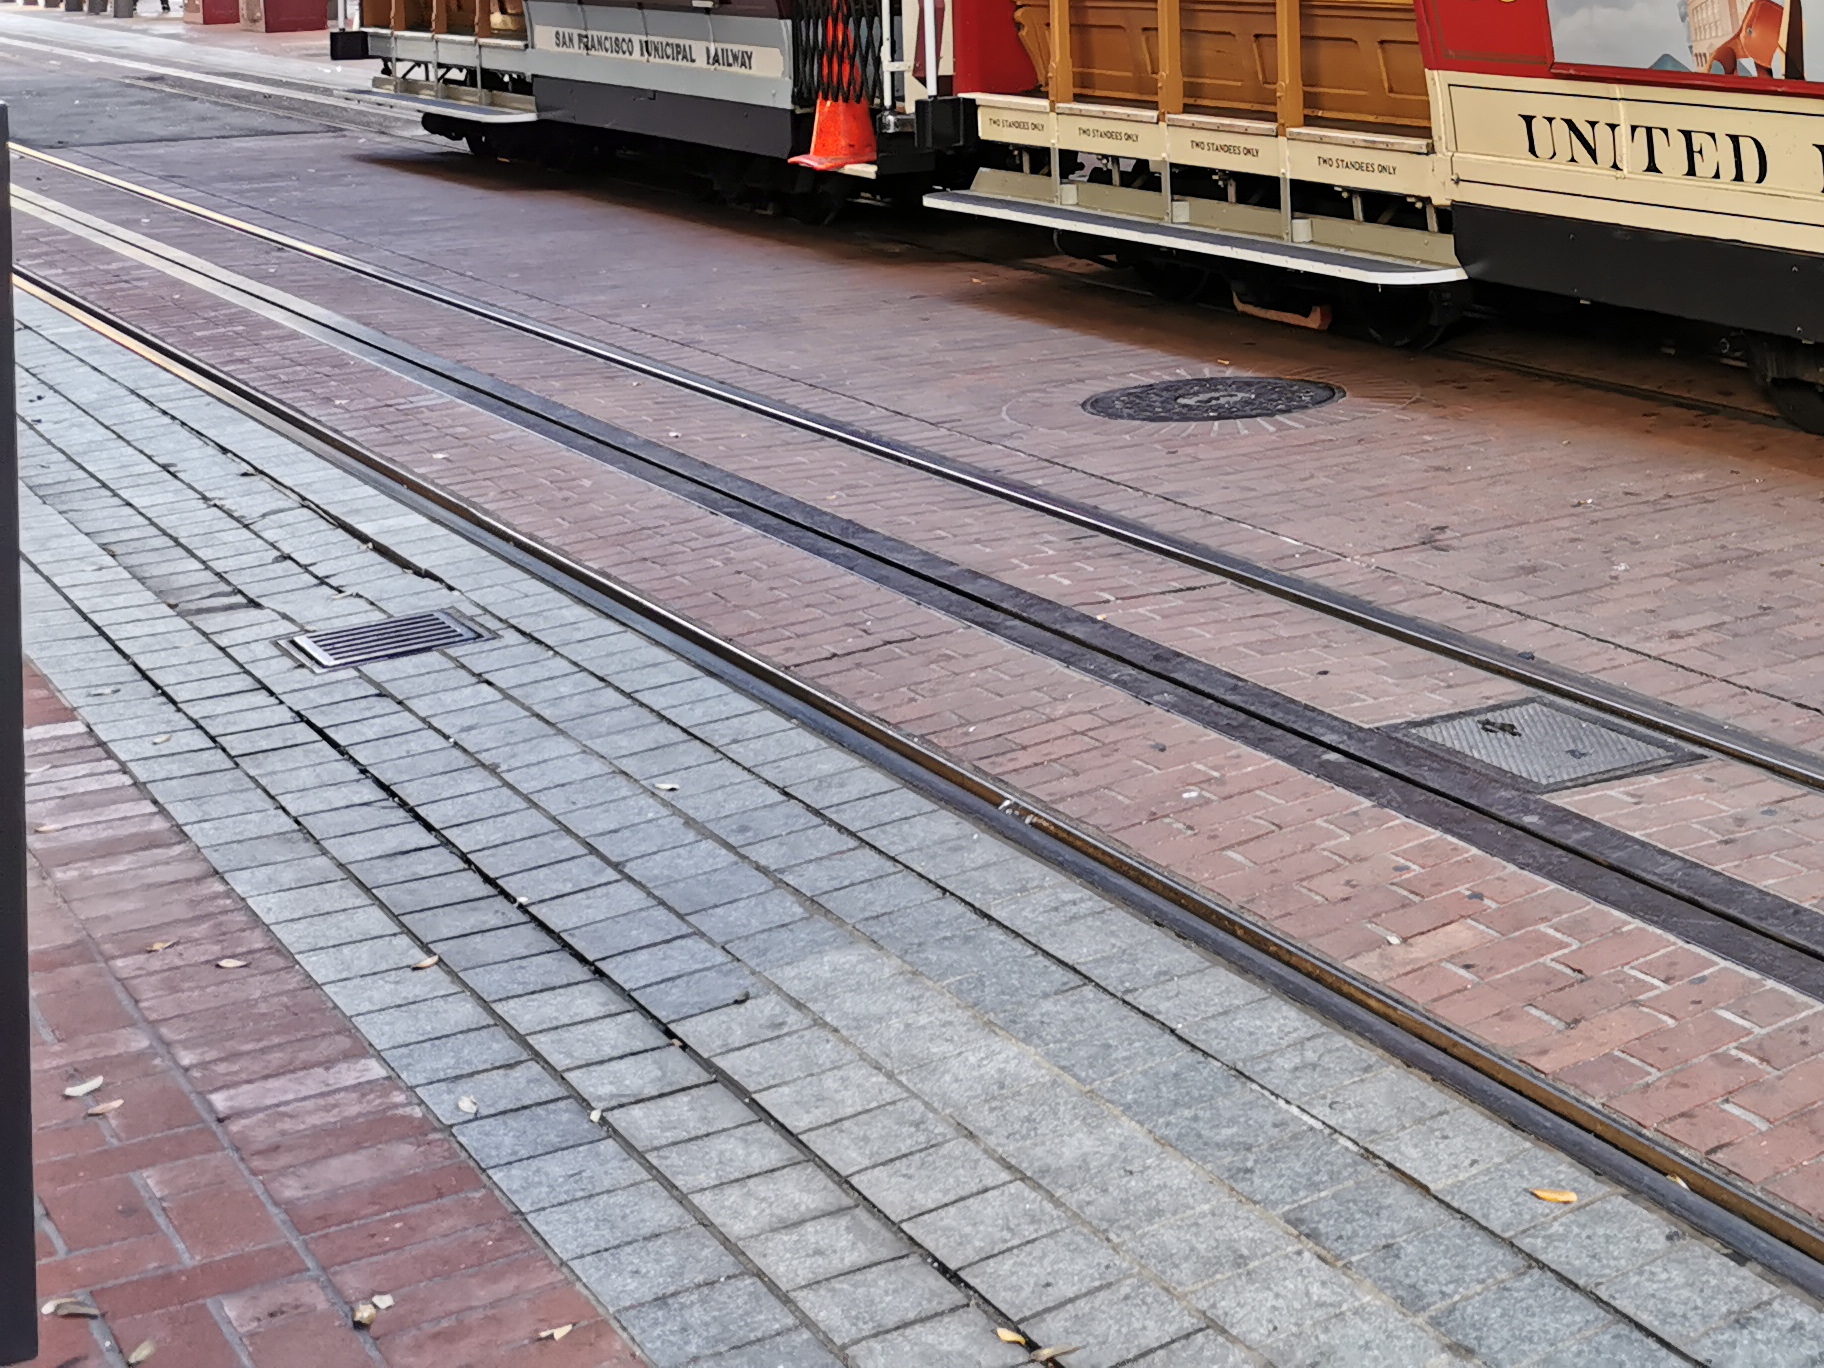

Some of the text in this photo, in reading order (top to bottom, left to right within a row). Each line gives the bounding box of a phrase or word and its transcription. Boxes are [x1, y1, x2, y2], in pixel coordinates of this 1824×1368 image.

[554, 30, 575, 49] SAN
[577, 33, 635, 57] FRANCISCO
[1078, 126, 1138, 143] TWO STANDEES ONLY
[1190, 139, 1259, 158] TWO STANDEES ONLY
[1518, 111, 1770, 185] UNITED
[1317, 155, 1397, 175] TWO STANDEES ONLY
